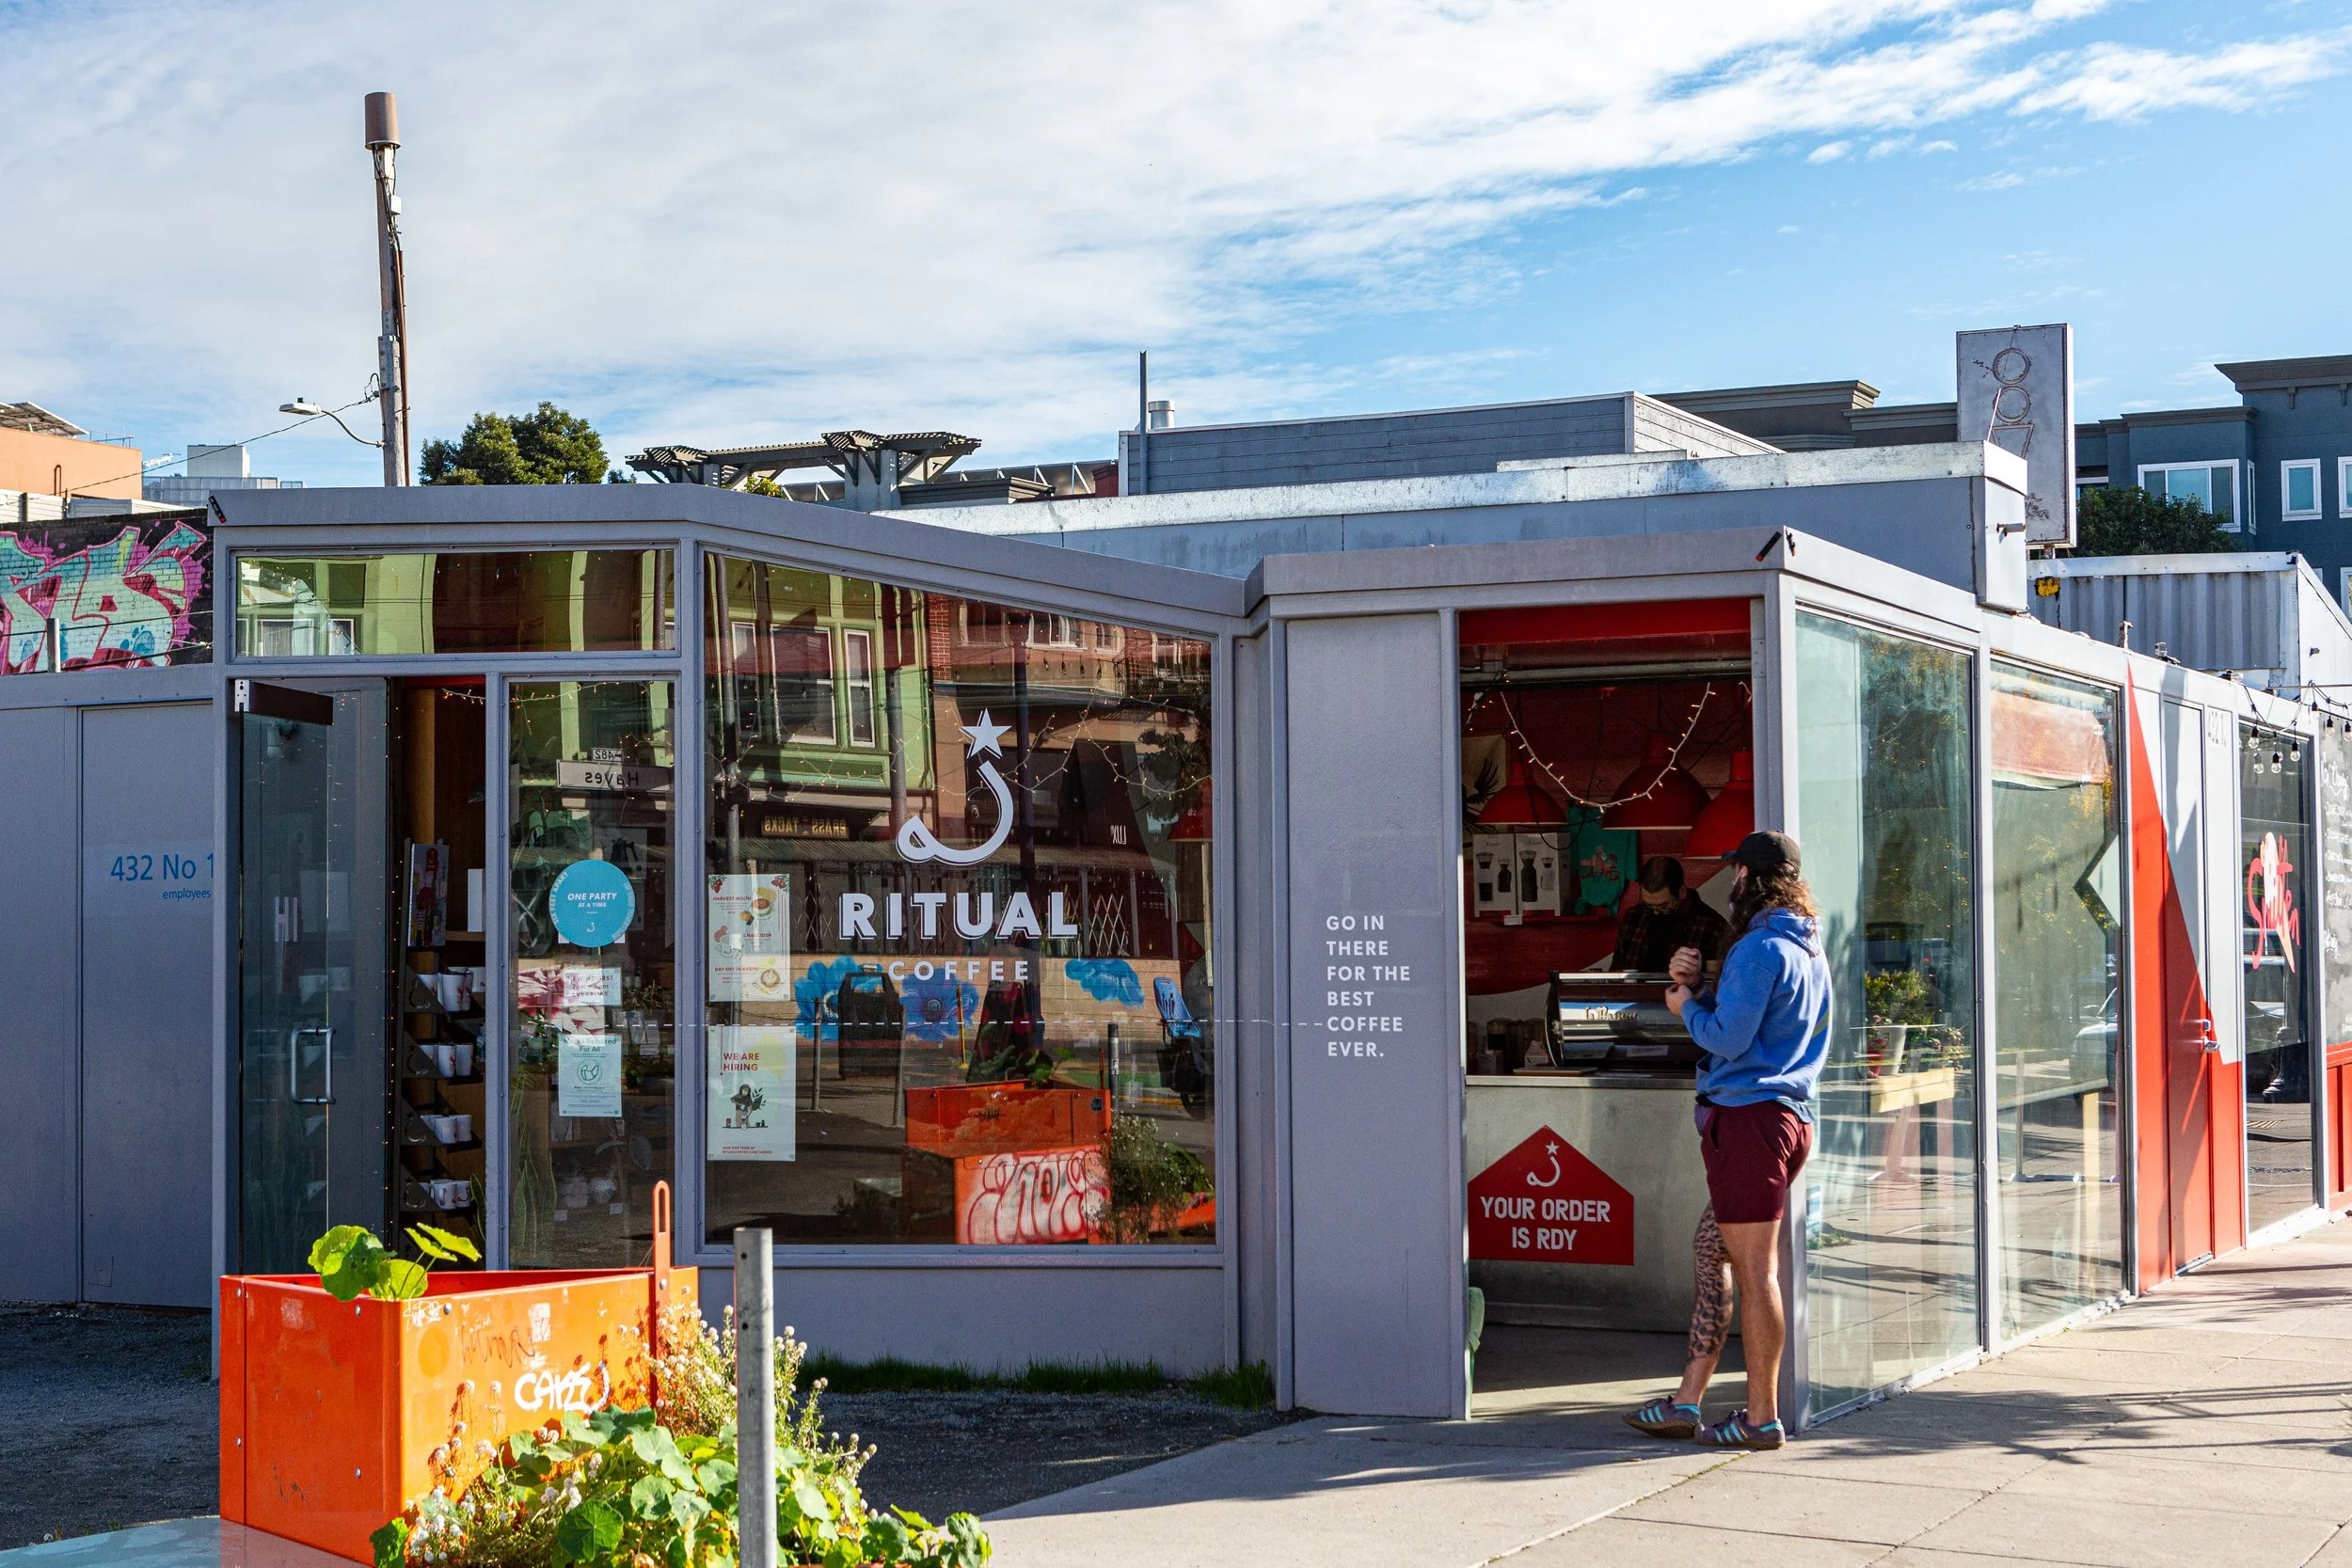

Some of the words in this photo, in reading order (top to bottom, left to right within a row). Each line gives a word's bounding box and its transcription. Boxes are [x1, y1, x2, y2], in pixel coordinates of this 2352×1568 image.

[111, 855, 153, 881] 432
[163, 853, 197, 879] No
[162, 887, 212, 901] employees
[567, 893, 587, 901] ONE
[589, 892, 618, 900] PARTY
[839, 892, 1078, 940] RITUAL
[1326, 915, 1356, 930] GO
[1363, 915, 1384, 930] IN
[1326, 941, 1389, 956] THERE
[888, 960, 1028, 981] COFFEE
[1327, 966, 1366, 981] FOR
[1373, 966, 1410, 981] THE
[1327, 991, 1375, 1006] BEST
[1327, 1016, 1403, 1032] COFFEE
[1327, 1041, 1385, 1057] EVER.
[1480, 1196, 1535, 1220] YOUR
[1541, 1198, 1611, 1223] ORDER
[1512, 1227, 1531, 1249] IS
[1536, 1227, 1577, 1251] RDY
